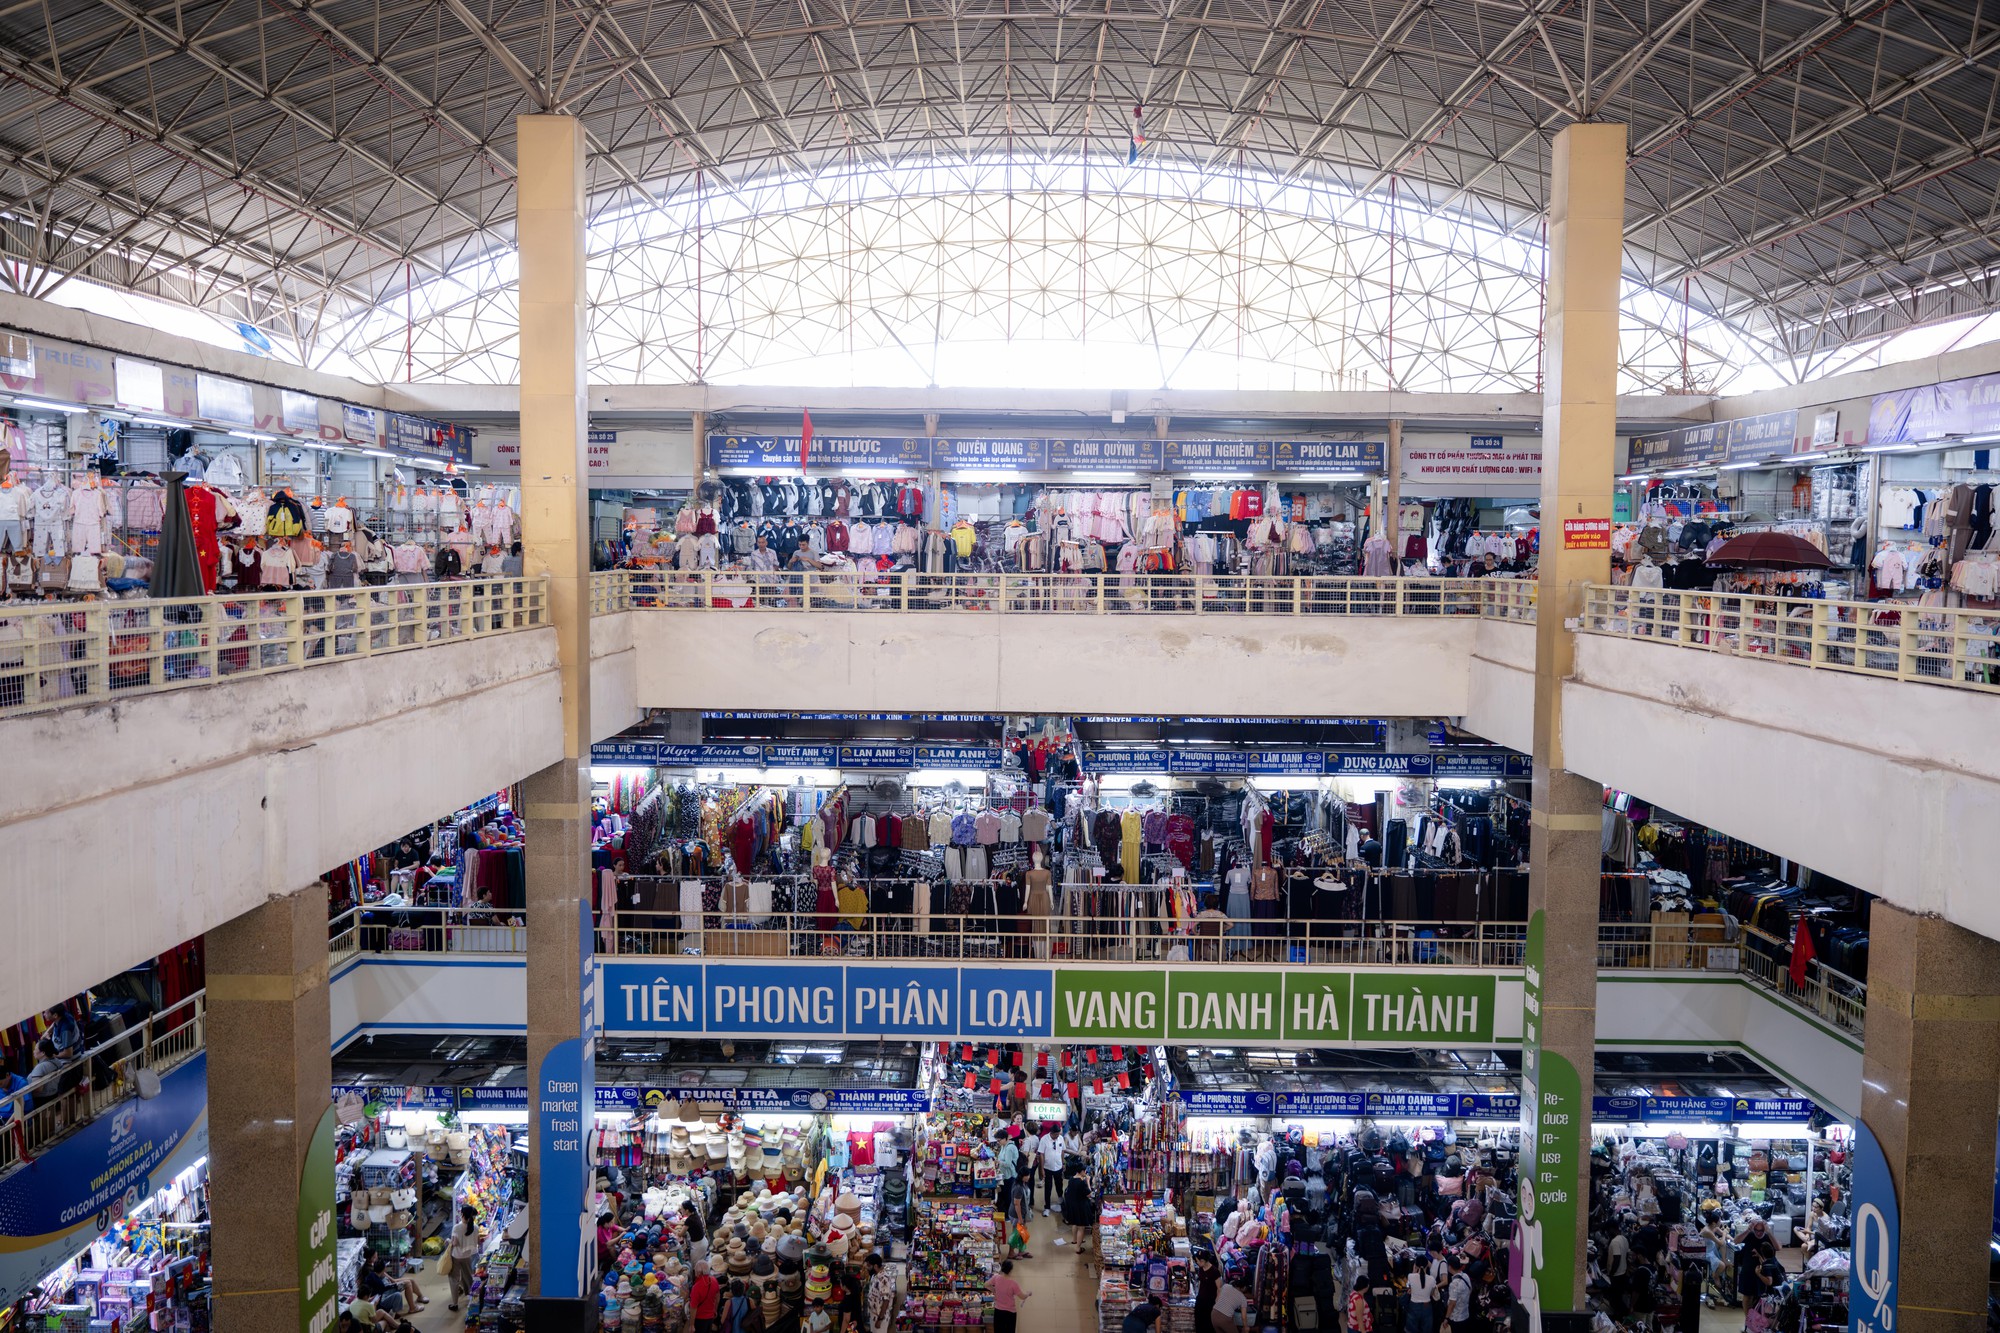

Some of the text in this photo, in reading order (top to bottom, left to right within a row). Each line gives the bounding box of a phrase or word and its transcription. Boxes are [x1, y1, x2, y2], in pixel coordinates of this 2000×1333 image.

[1765, 421, 1780, 438] LAN
[1684, 431, 1699, 446] LAN
[829, 438, 881, 454] THƯỢC
[905, 440, 915, 452] C1
[957, 439, 1024, 455] QUYÊN QUANG
[1073, 439, 1135, 456] CẢNH QUỲNH
[1182, 443, 1255, 459] MẠNH NGHIÊM
[1300, 443, 1359, 458] PHÚC LAN
[1410, 450, 1427, 460] CÔNG
[1512, 452, 1529, 461] PHÁT
[1436, 466, 1451, 474] DỊCH
[1461, 464, 1478, 473] CHẤT
[1479, 465, 1500, 474] LƯỢNG
[1501, 466, 1515, 474] CAO
[1519, 466, 1533, 474] WIFI
[593, 744, 636, 754] DUNG VIỆT
[660, 745, 740, 757] Ngọc Hoàn
[777, 746, 819, 756] TUYẾT ANH
[854, 749, 895, 757] LAN ANH
[930, 749, 986, 758] LAN ANH
[1099, 753, 1131, 761] PHƯƠNG
[1180, 752, 1212, 761] PHƯƠNG
[1262, 752, 1303, 763] LÂM OANH
[1344, 756, 1408, 769] DUNG LOAN
[620, 976, 694, 1023] TIÊN
[715, 985, 834, 1024] PHONG
[856, 980, 948, 1026] PHÂN
[970, 989, 1042, 1034] LOẠI
[1064, 990, 1157, 1030] VANG
[1177, 991, 1272, 1031] DANH
[1294, 985, 1339, 1031] HÀ
[1363, 986, 1477, 1033] THÀNH
[548, 1080, 578, 1093] Green
[596, 1086, 618, 1099] TRÀ
[679, 1087, 779, 1099] DUNG TRÀ
[475, 1087, 528, 1101] QUANG THẮN
[839, 1090, 875, 1101] THÀNH
[879, 1091, 908, 1101] PHÚC
[1207, 1094, 1246, 1104] PHƯƠNG SILK
[1293, 1093, 1347, 1104] HẢI HƯƠNG
[1383, 1095, 1434, 1105] NAM OANH
[1544, 1092, 1564, 1106] Re-
[541, 1099, 579, 1113] market
[1033, 1104, 1048, 1113] LỐI
[1660, 1098, 1707, 1109] THU HẰNG
[1755, 1101, 1802, 1110] MINH THƠ
[1542, 1111, 1569, 1125] duce
[110, 1111, 134, 1143] 5G
[551, 1118, 578, 1132] fresh
[107, 1132, 137, 1157] vinaphone
[553, 1138, 579, 1151] start
[1542, 1132, 1560, 1144] re-
[1541, 1152, 1561, 1164] use
[90, 1153, 134, 1192] VINAPHONE
[134, 1140, 153, 1161] DATA
[60, 1206, 76, 1223] GÓI
[76, 1201, 95, 1216] GỌN
[95, 1187, 109, 1204] THẾ
[109, 1178, 126, 1196] GIỚI
[126, 1158, 151, 1184] TRONG
[150, 1145, 165, 1164] TAY
[164, 1129, 179, 1151] BẠN
[1541, 1172, 1558, 1183] re-
[1540, 1189, 1567, 1205] cycle
[306, 1253, 336, 1301] LỒNG,
